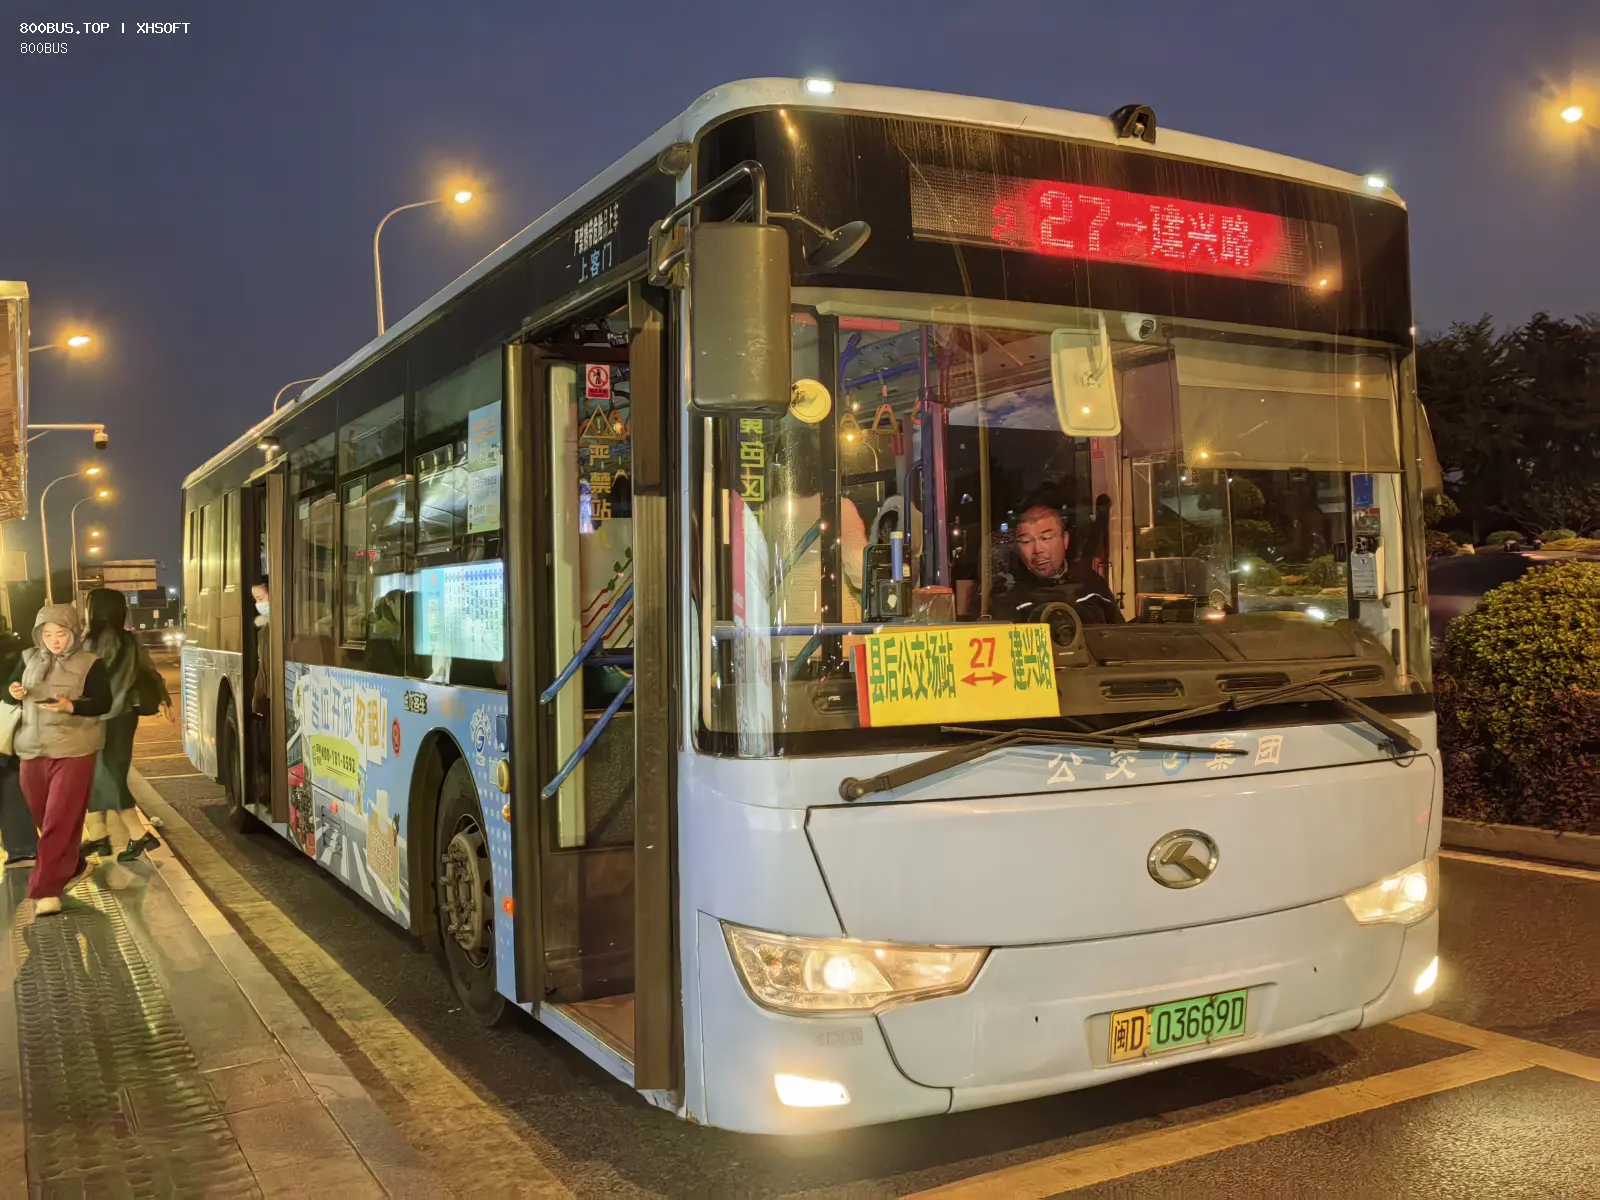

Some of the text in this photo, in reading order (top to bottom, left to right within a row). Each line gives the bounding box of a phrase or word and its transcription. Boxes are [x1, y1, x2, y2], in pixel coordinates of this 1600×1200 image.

[1040, 190, 1112, 252] 27
[1149, 203, 1254, 268] 建兴路
[869, 625, 1053, 704] 县后公交场站 27 建兴路
